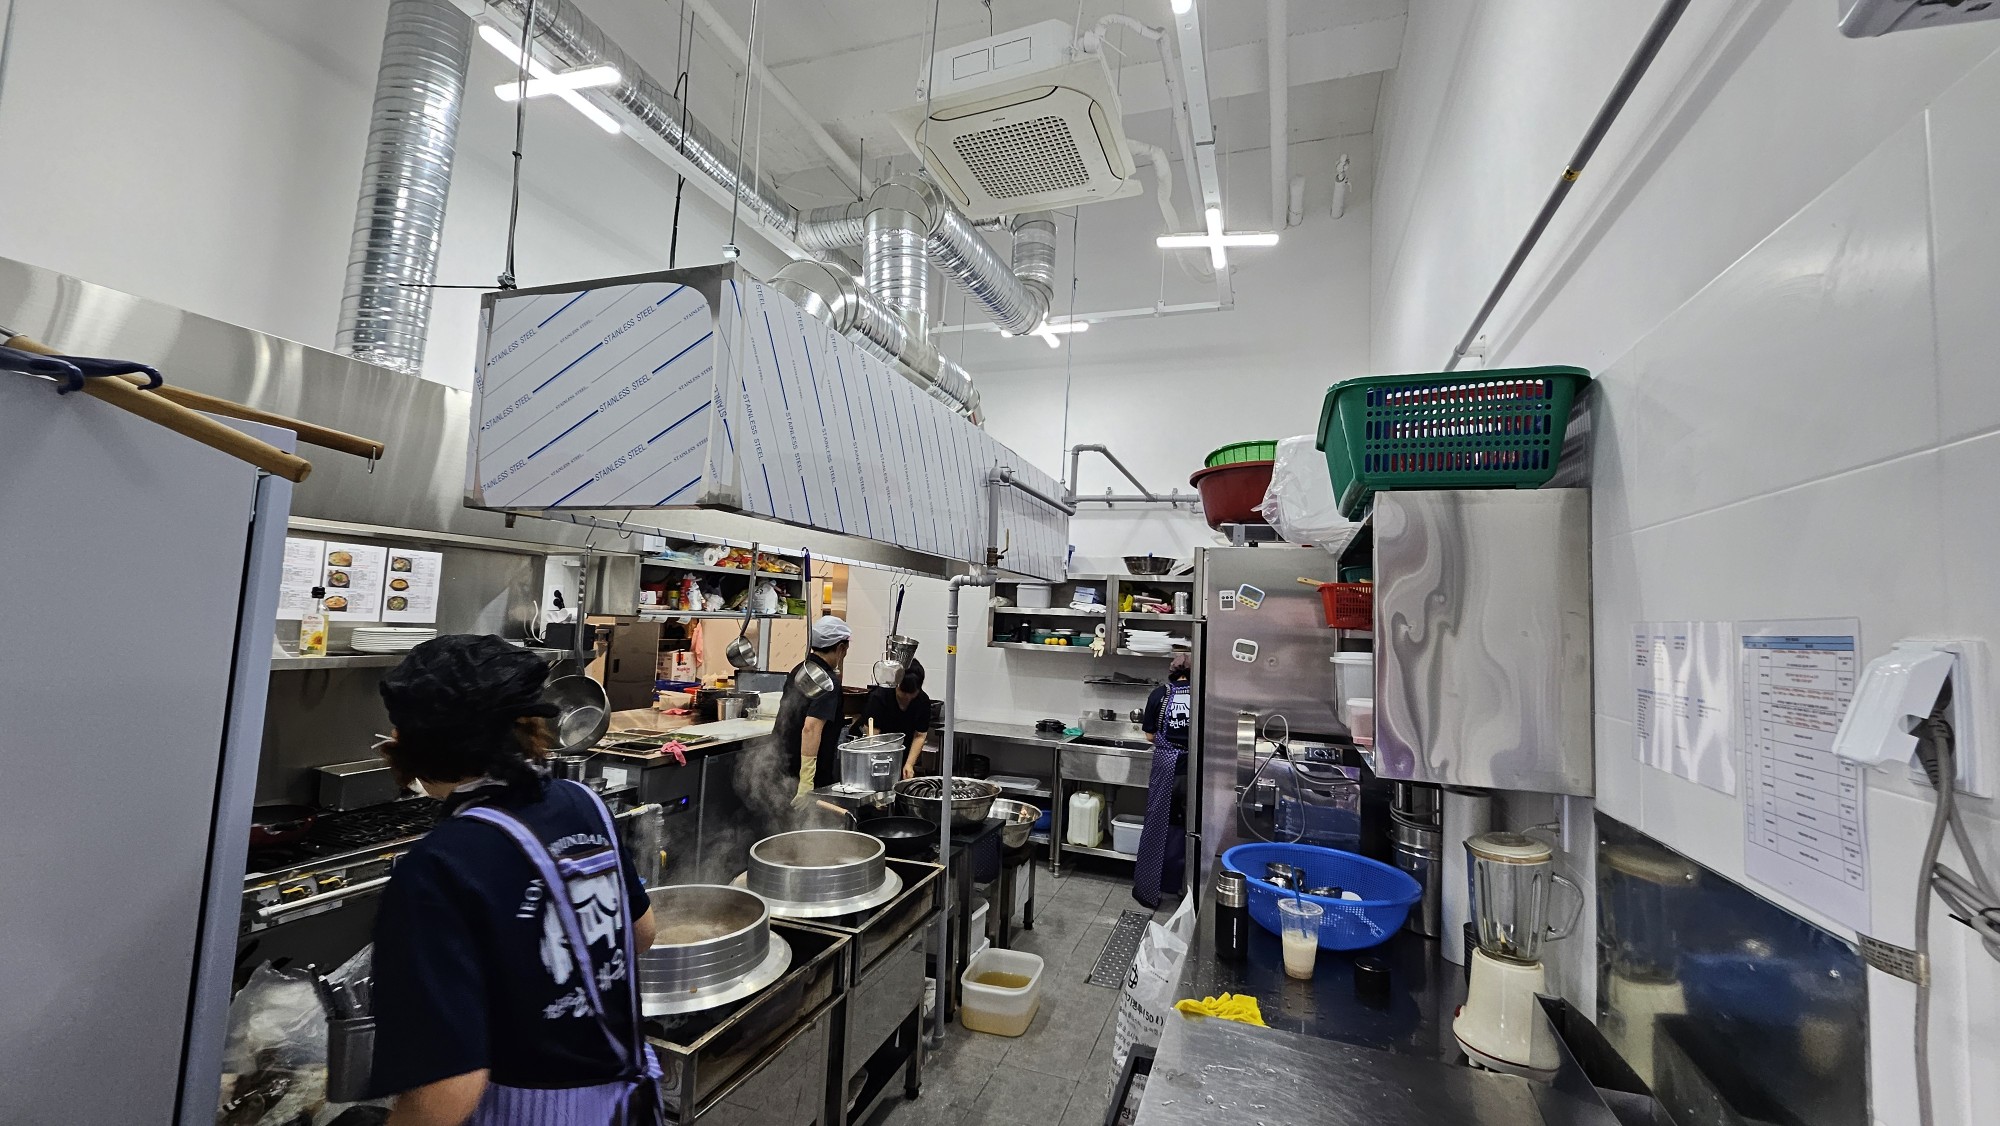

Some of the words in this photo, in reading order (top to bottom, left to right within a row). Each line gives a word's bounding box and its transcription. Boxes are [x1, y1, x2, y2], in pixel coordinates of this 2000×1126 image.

[603, 318, 635, 345] STAINLESS
[636, 305, 657, 322] STEEL
[491, 340, 519, 366] STAINLESS
[520, 328, 538, 344] STEEL
[485, 405, 514, 430] STAINLESS
[515, 393, 533, 409] STEEL
[599, 386, 631, 413] STAINLESS
[631, 374, 652, 391] STEEL
[743, 394, 758, 435] STAINLESS
[754, 438, 764, 463] STEEL
[786, 412, 798, 450] STAINLESS
[795, 452, 803, 473] STEEL
[480, 470, 508, 494] STAINLESS
[509, 459, 528, 474] STEEL
[594, 455, 626, 482] STAINLESS
[627, 443, 648, 460] STEEL
